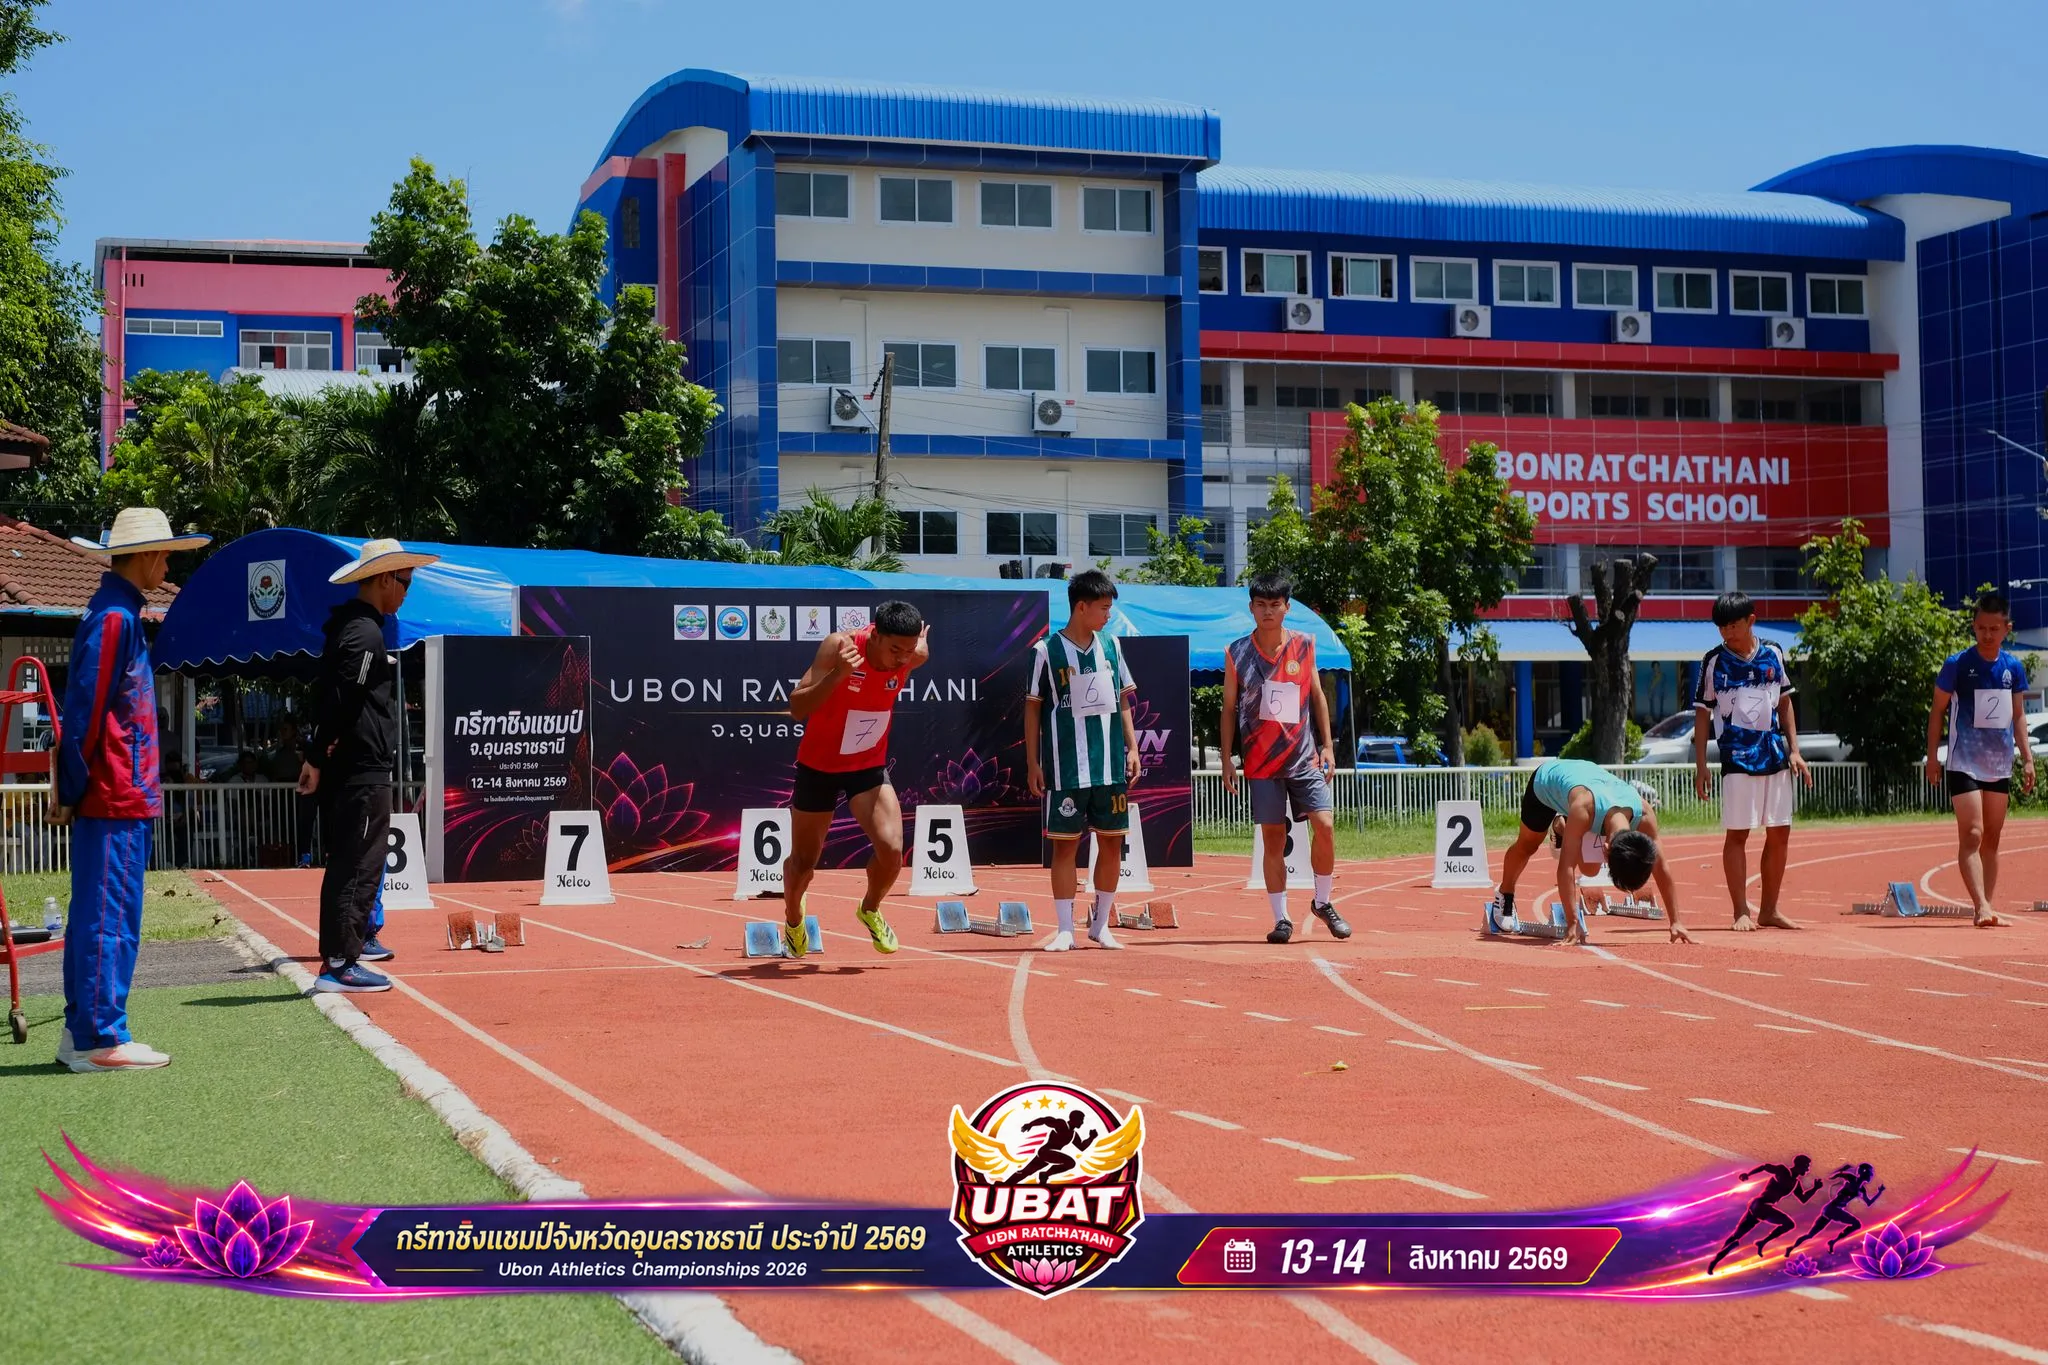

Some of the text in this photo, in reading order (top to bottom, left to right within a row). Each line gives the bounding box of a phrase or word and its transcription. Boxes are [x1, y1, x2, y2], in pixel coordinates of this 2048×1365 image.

[1495, 451, 1790, 485] BONRATCHATHANI
[1647, 492, 1767, 522] SCHOOL
[610, 678, 977, 703] UBON RATHANI
[1086, 676, 1099, 704] 6
[1269, 689, 1283, 716] 5
[1741, 696, 1763, 724] 3
[1985, 696, 2000, 720] 2
[454, 709, 584, 736] กรีฑาชิงแชมป์
[856, 719, 878, 746] 7
[523, 762, 539, 770] 2569
[505, 776, 541, 788] สิงหาคม
[543, 776, 567, 787] 2569
[1111, 793, 1127, 814] 10
[560, 825, 590, 872] 7
[753, 820, 782, 866] 6
[927, 818, 954, 864] 5
[1447, 815, 1473, 857] 2
[387, 827, 408, 874] 8
[750, 869, 783, 882] Nelco
[923, 866, 955, 880] Nelco
[1444, 861, 1475, 873] Nelco
[383, 878, 409, 891] elco
[557, 875, 591, 888] Nelco
